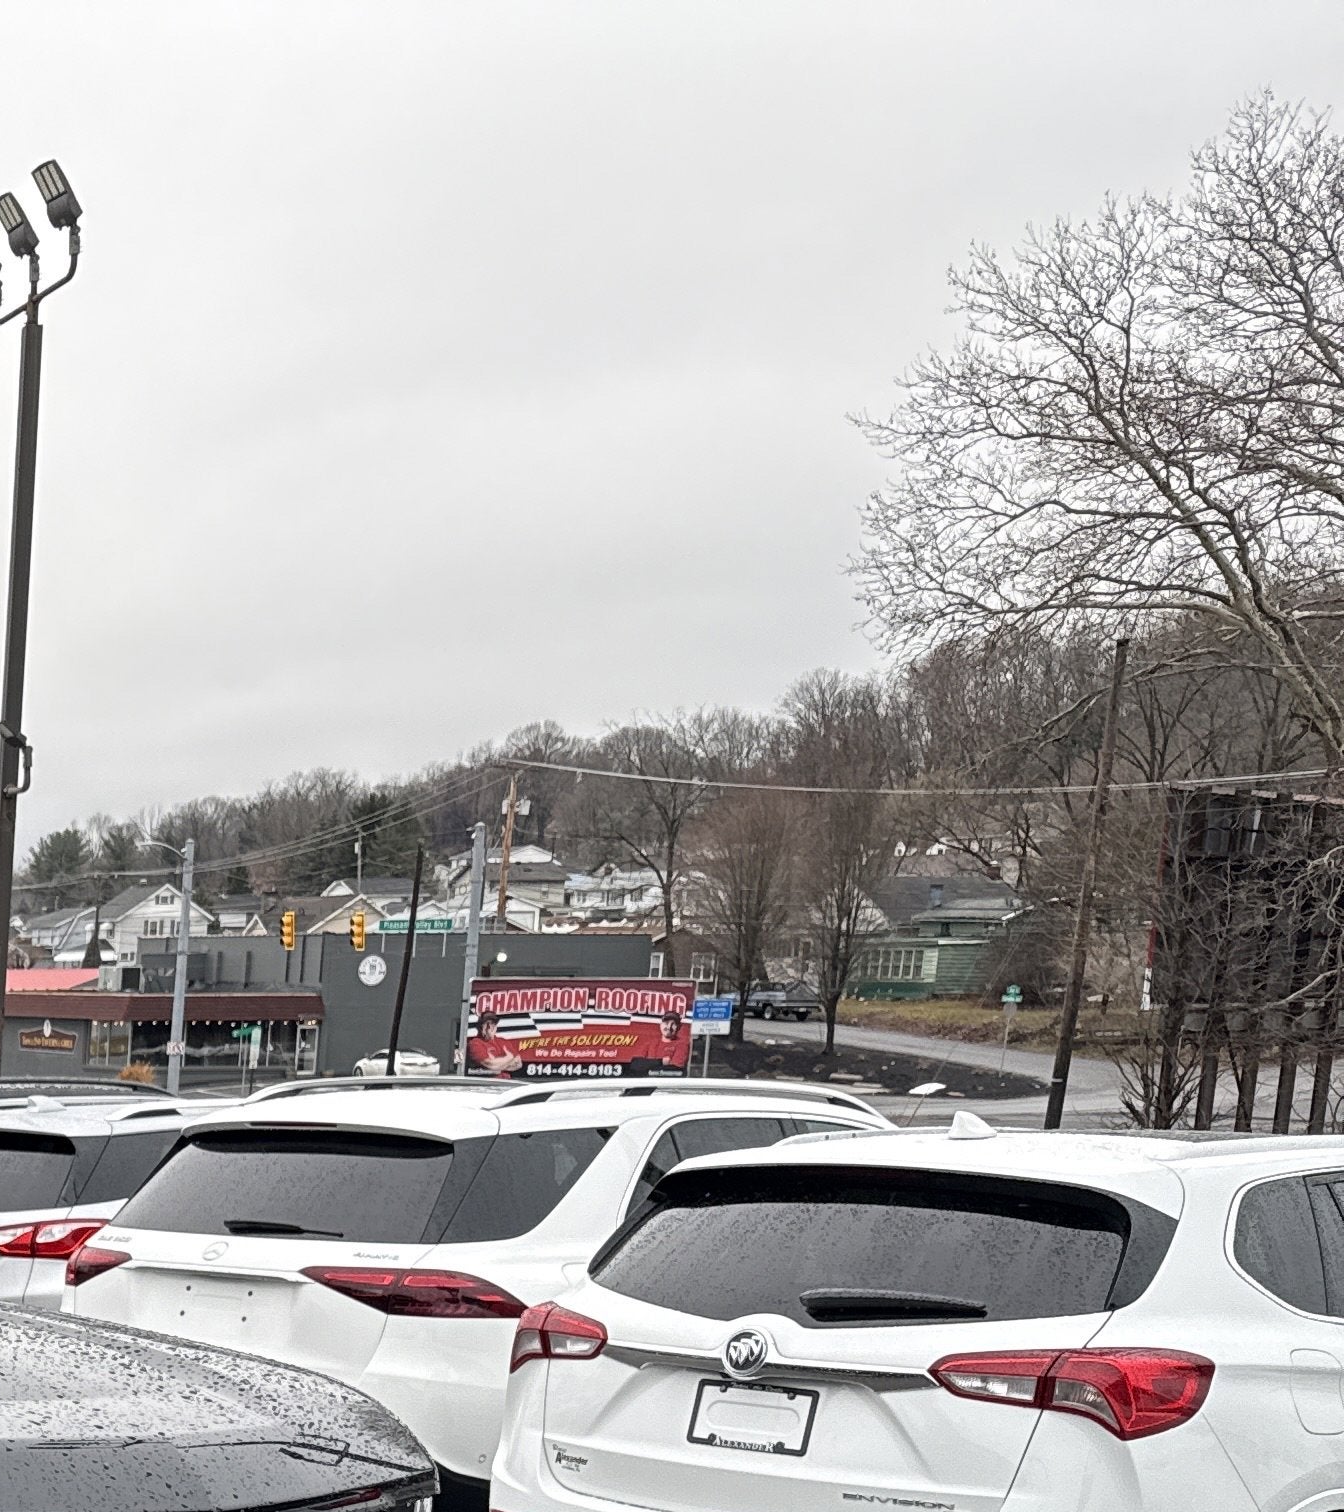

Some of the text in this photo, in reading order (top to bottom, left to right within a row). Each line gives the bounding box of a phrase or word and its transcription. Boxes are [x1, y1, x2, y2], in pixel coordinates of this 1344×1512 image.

[476, 988, 589, 1014] CHAMPION
[595, 988, 688, 1018] ROOFING
[571, 1034, 638, 1047] SOLUTION!
[535, 1049, 617, 1058] We Do Repairs Too!
[842, 1493, 955, 1510] ENVISION
